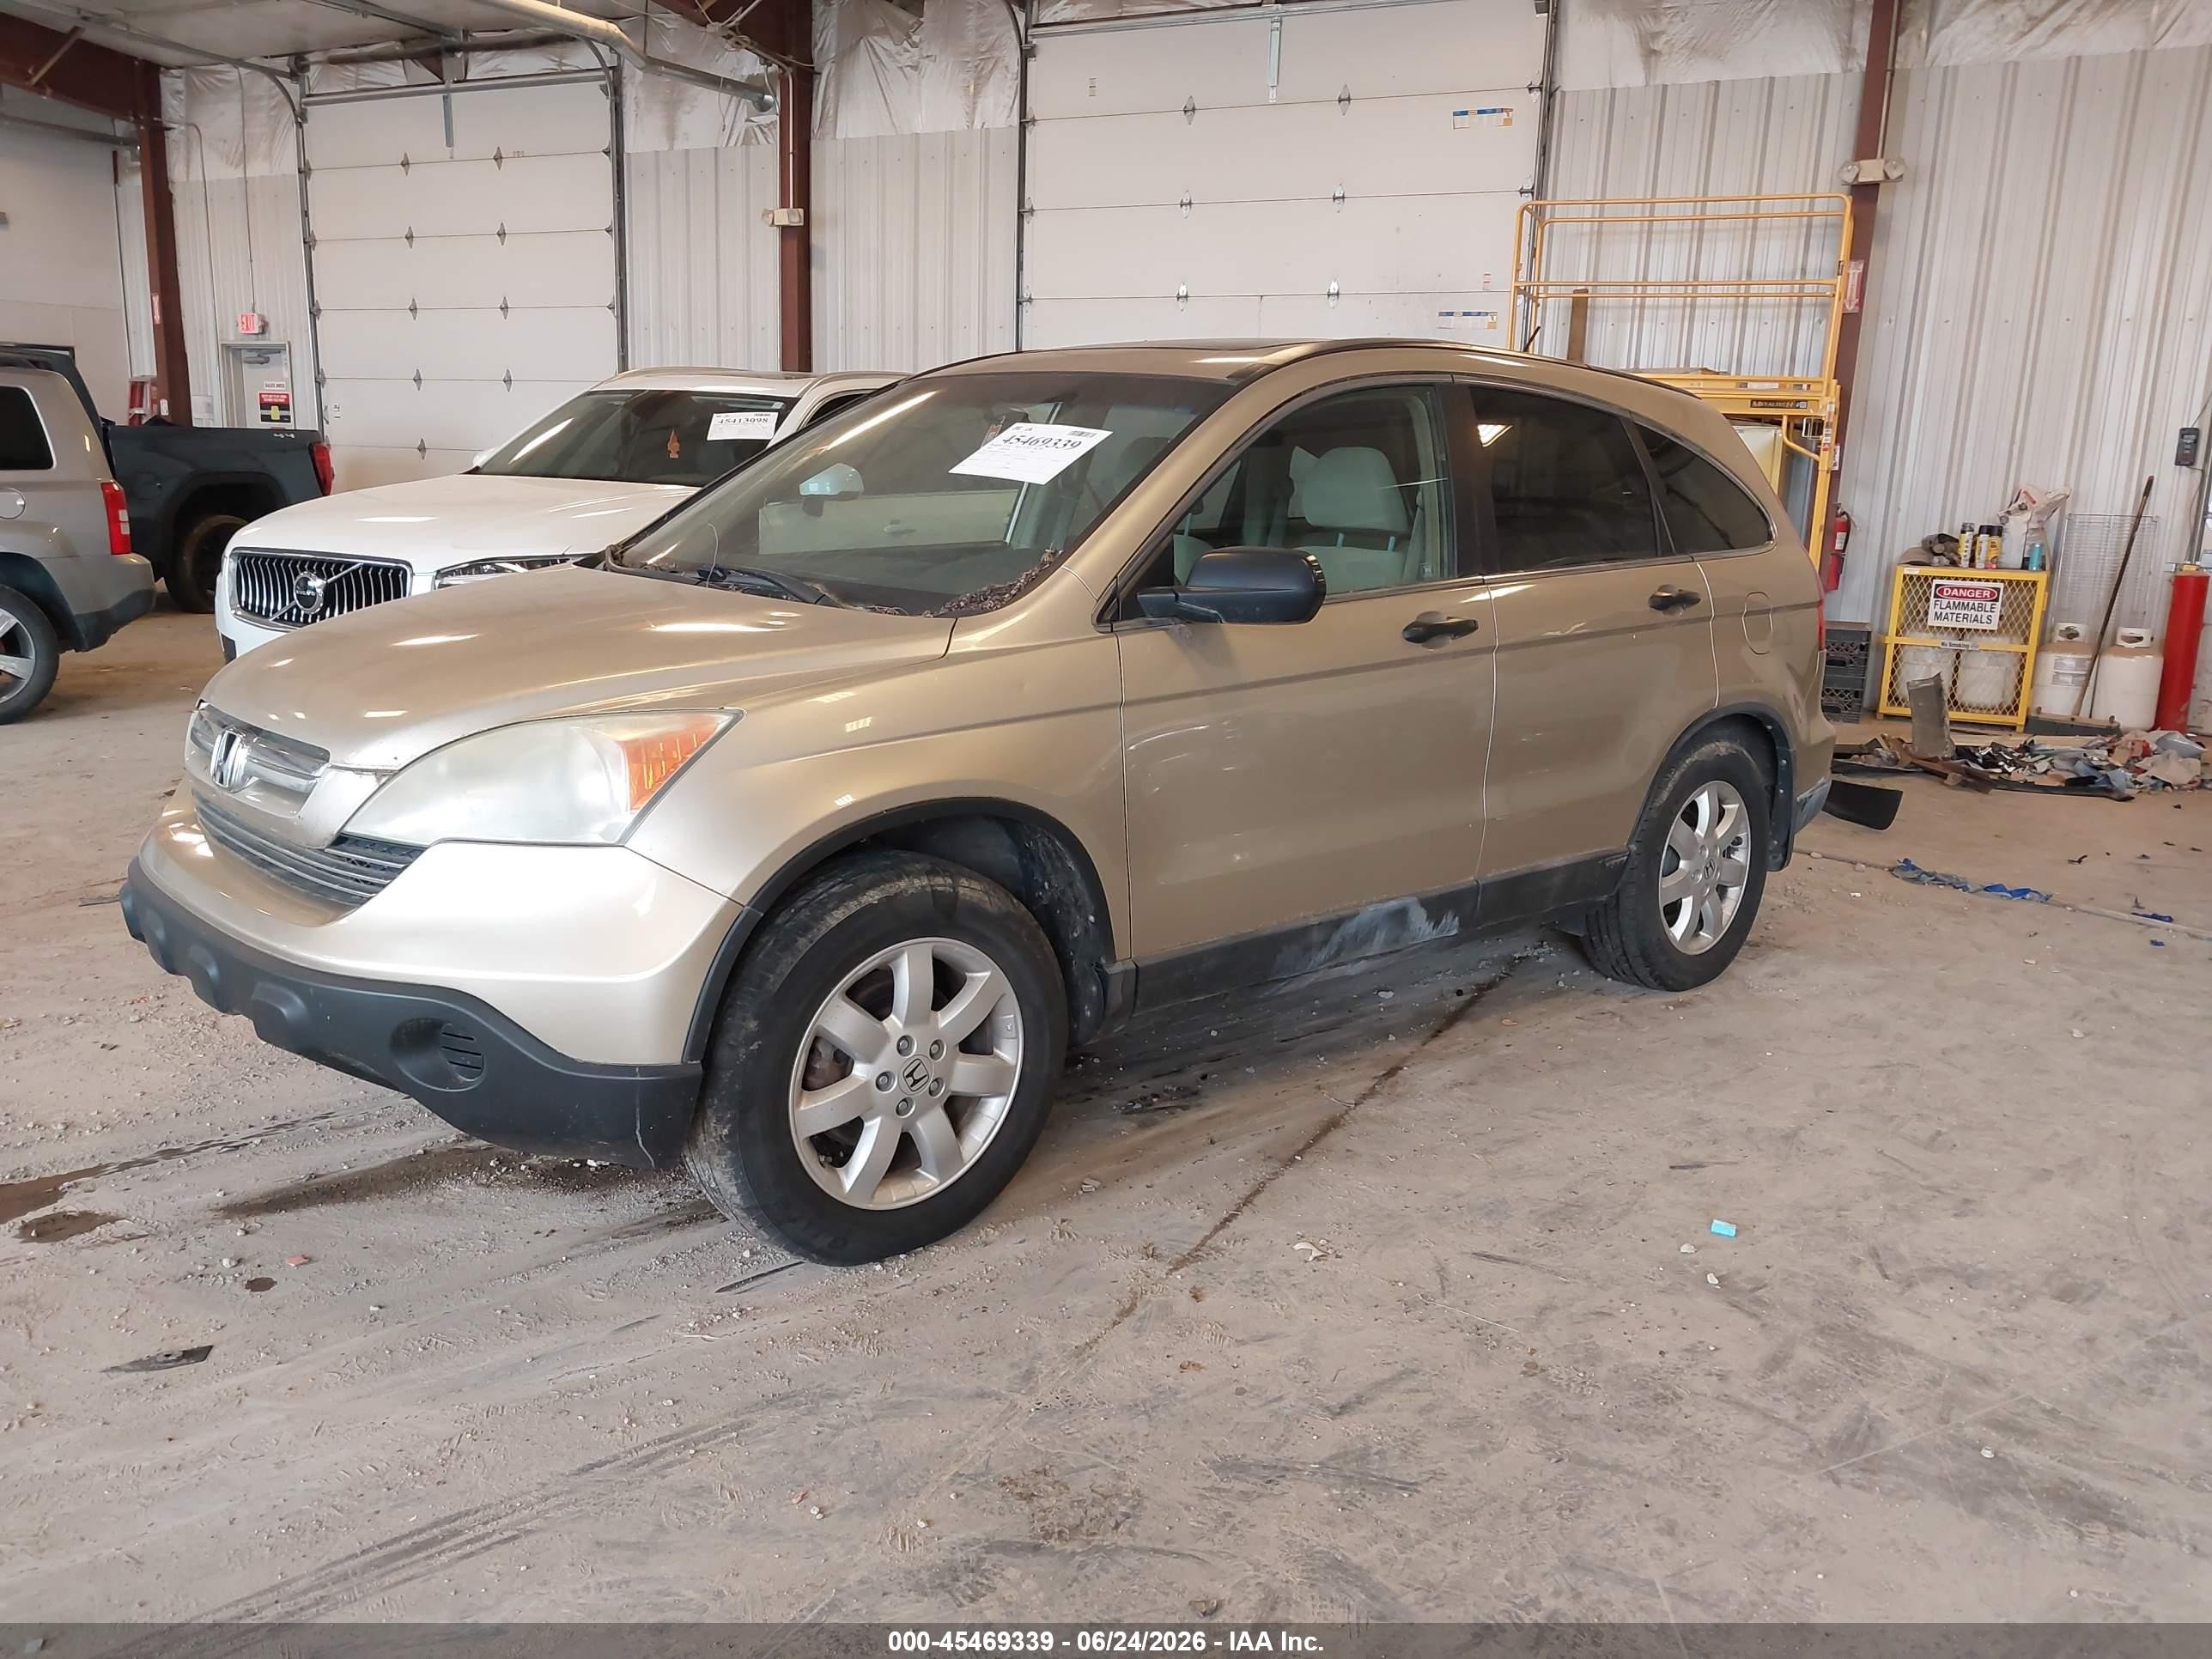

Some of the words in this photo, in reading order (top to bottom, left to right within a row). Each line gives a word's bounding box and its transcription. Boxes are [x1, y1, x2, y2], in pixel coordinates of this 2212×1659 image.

[1002, 434, 1083, 450] 45469339
[1943, 587, 1991, 598] DANGER
[1933, 599, 1996, 612] FLAMMABLE
[1933, 611, 1993, 624] MATERIALS
